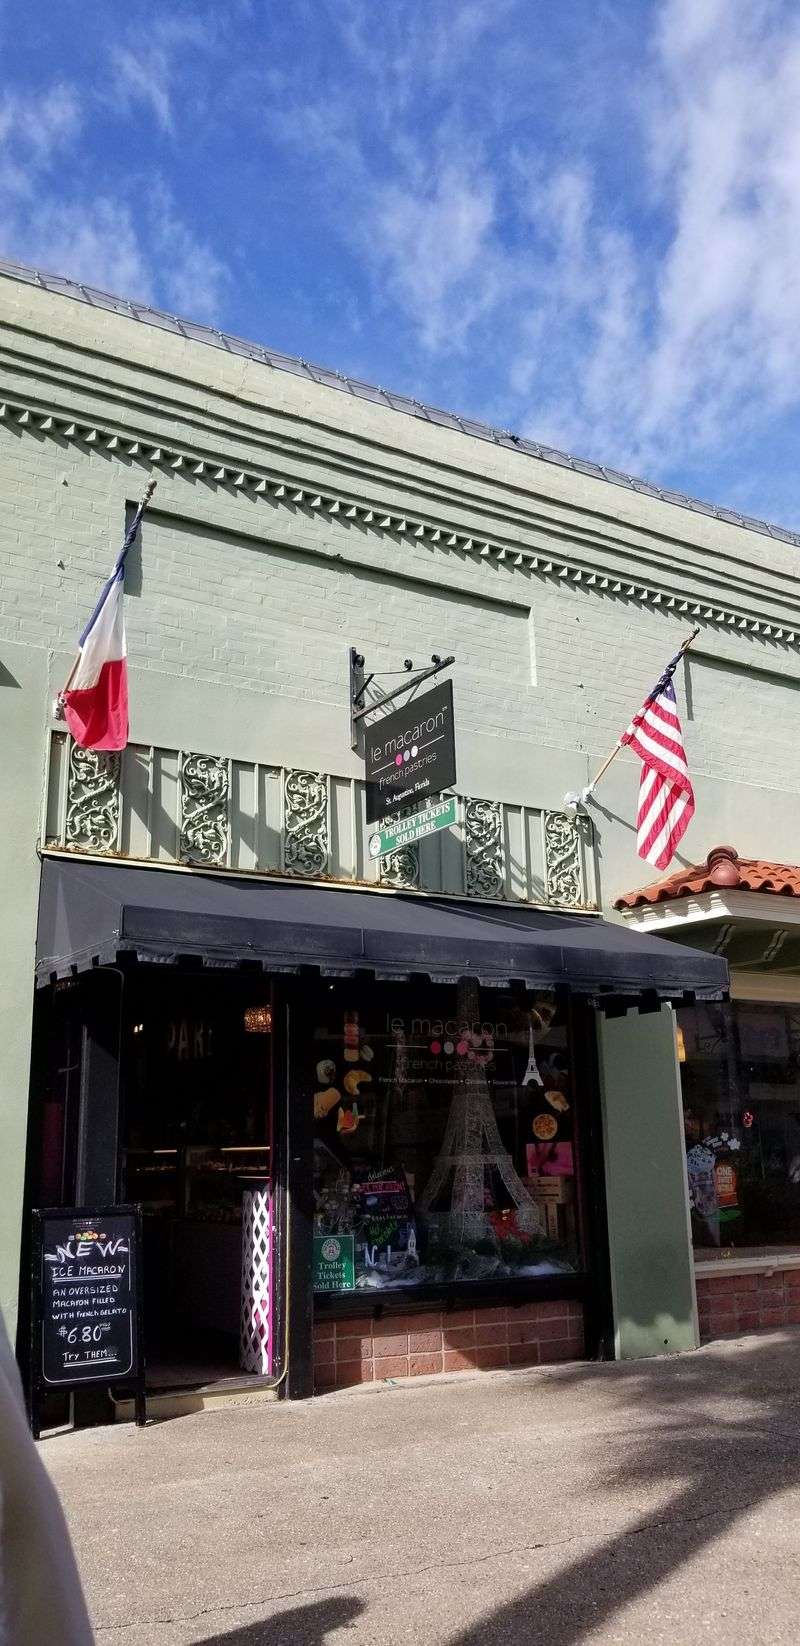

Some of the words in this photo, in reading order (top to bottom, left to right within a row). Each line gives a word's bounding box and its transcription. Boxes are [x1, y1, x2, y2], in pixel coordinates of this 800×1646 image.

[371, 742, 382, 764] le
[384, 711, 444, 757] macaron
[377, 768, 404, 791] french
[404, 751, 437, 777] pastries
[414, 777, 430, 791] Florida
[385, 815, 417, 840] TROLLEY
[419, 801, 451, 824] TICKETS
[395, 827, 415, 846] SOLD
[416, 820, 437, 838] HERE
[386, 1012, 404, 1034] le
[411, 1017, 508, 1037] macaron
[56, 1238, 124, 1263] NEW
[52, 1265, 74, 1277] ICE
[78, 1264, 126, 1276] MACARON
[319, 1261, 346, 1271] Trolley
[318, 1271, 346, 1280] Tickets
[52, 1288, 67, 1297] AN
[68, 1284, 119, 1296] OVERSIZED
[332, 1280, 352, 1289] Here
[91, 1297, 115, 1305] FILLED
[52, 1311, 75, 1320] WITH
[100, 1307, 127, 1315] GELATO
[57, 1325, 102, 1344] $6.80
